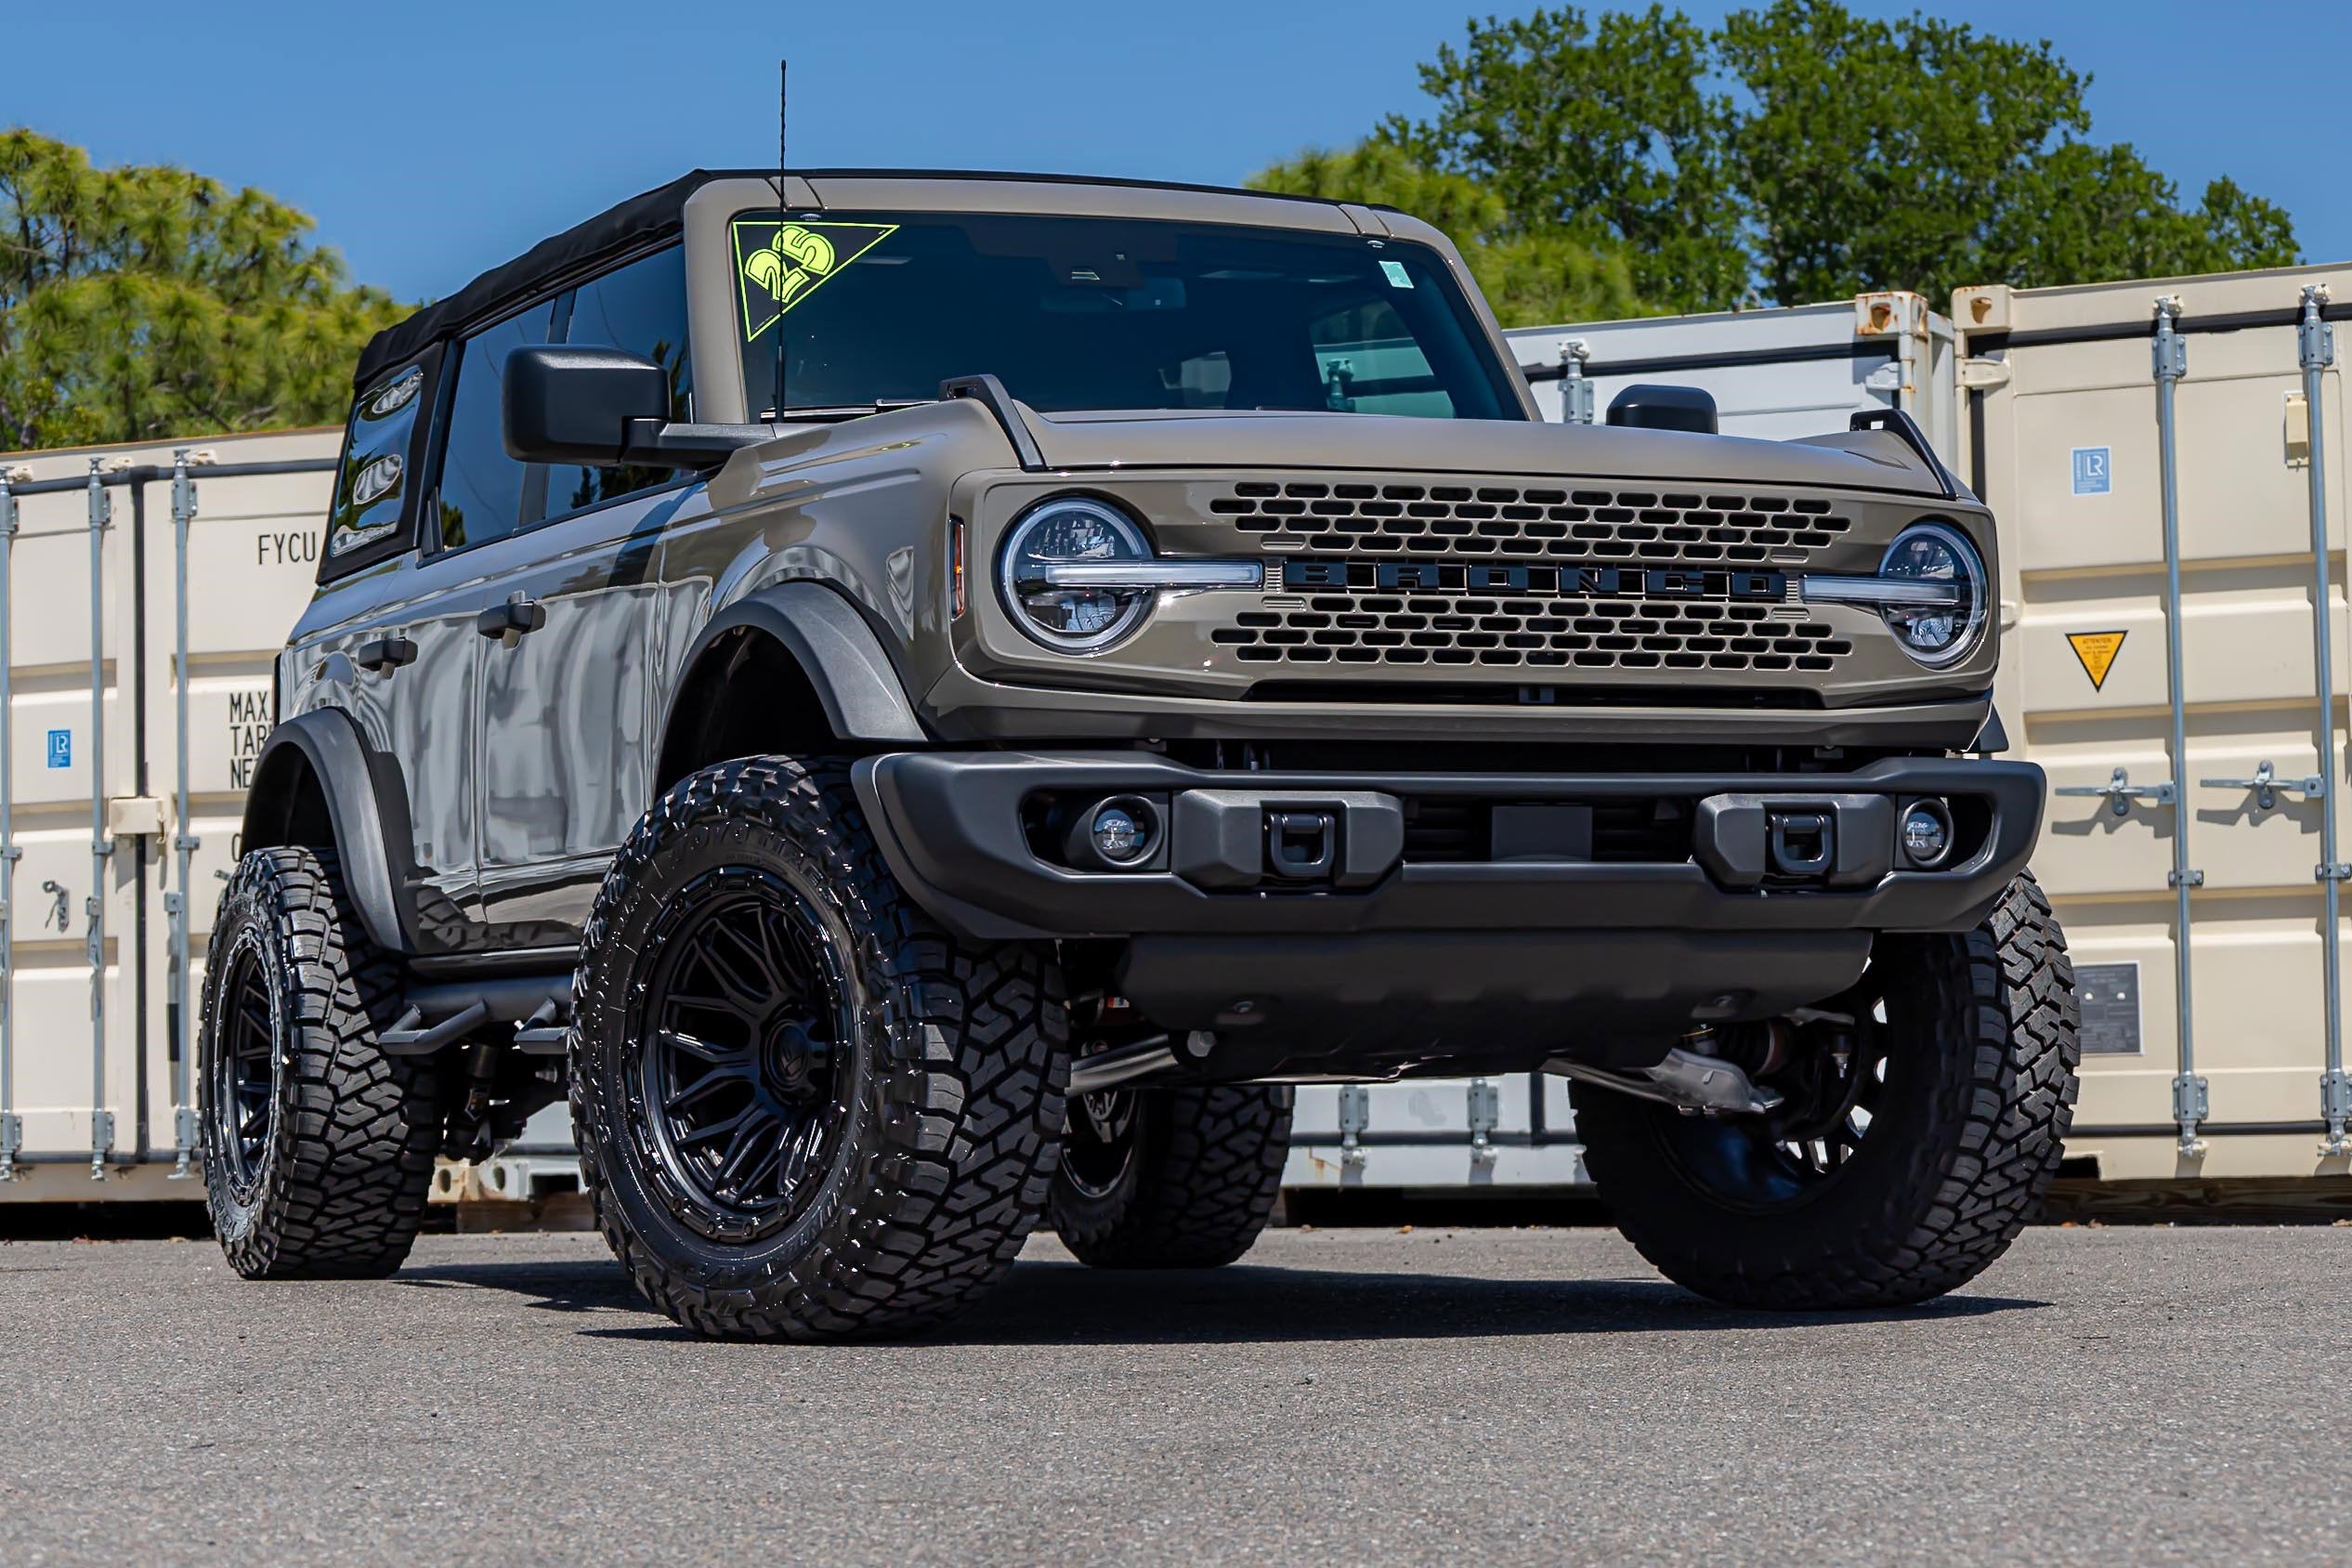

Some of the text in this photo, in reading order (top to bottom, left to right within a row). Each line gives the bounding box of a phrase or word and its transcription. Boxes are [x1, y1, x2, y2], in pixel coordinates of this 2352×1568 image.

[744, 225, 835, 304] 25
[258, 531, 316, 565] FYCU
[1283, 560, 1786, 600] BRONCO
[230, 725, 273, 755] TAR
[230, 758, 258, 789] NE
